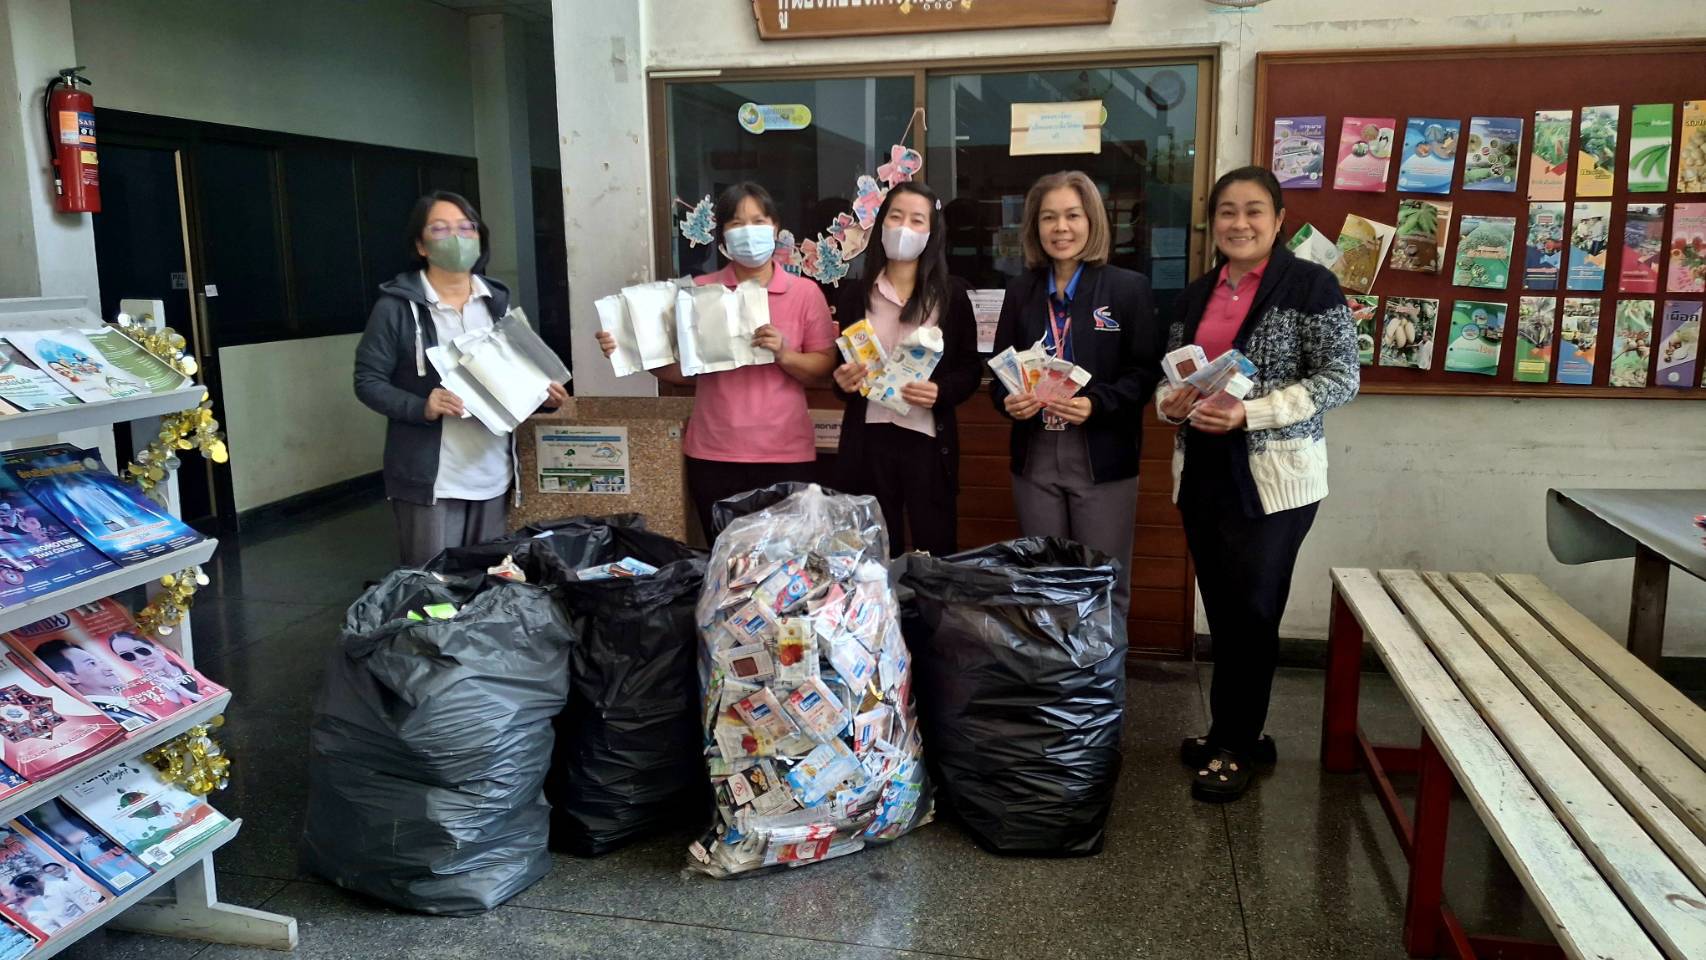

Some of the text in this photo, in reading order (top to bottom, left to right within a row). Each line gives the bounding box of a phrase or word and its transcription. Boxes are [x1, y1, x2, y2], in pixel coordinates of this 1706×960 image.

[28, 537, 79, 554] PROMOTING
[34, 549, 53, 559] THAI
[52, 542, 85, 555] CULTURE
